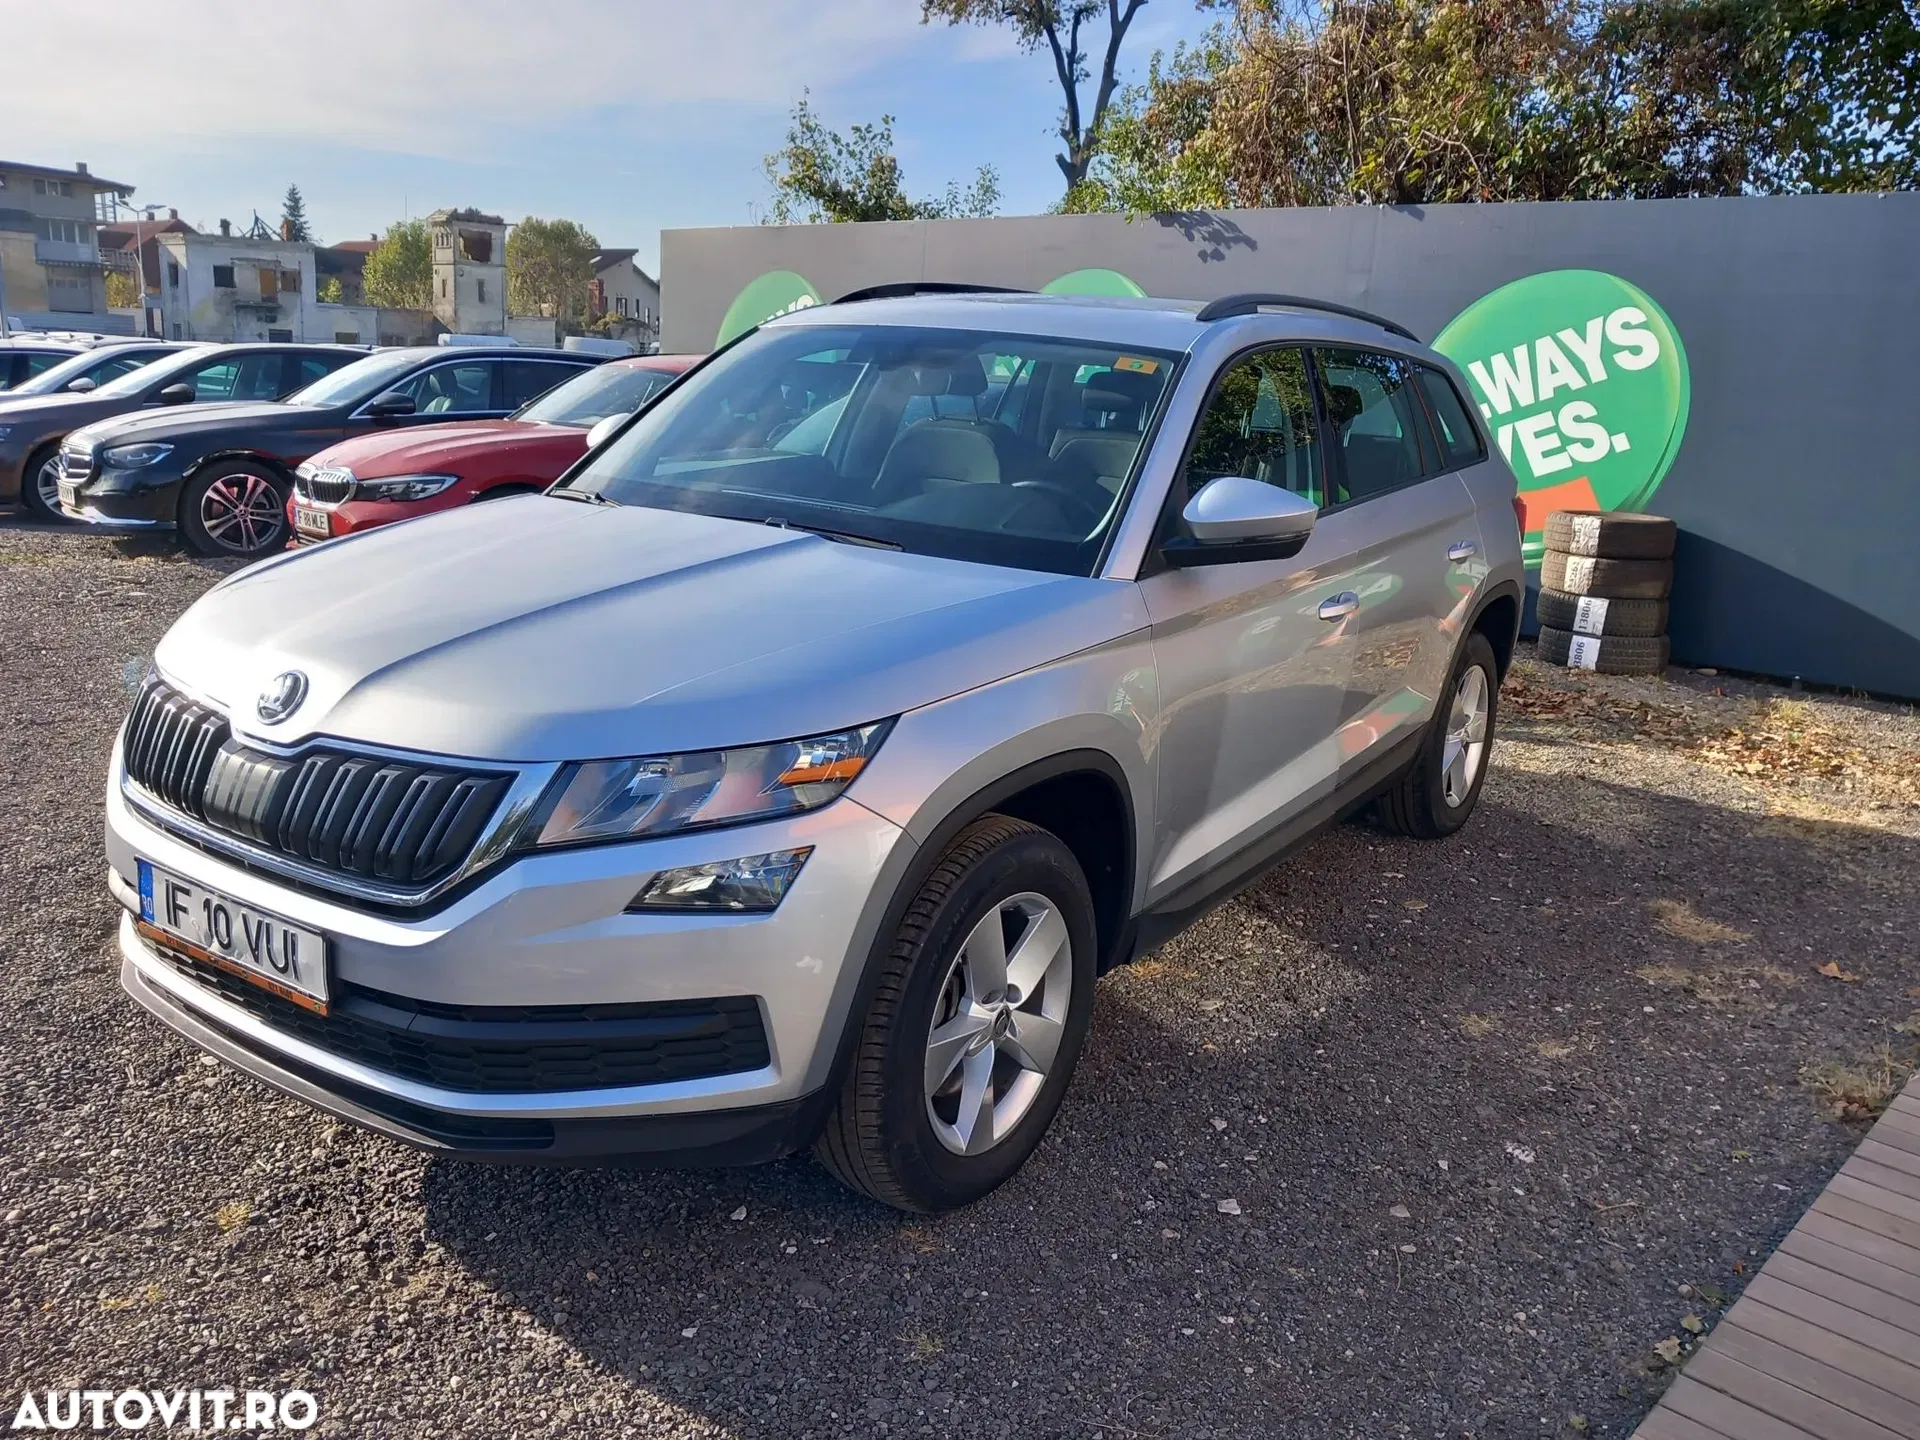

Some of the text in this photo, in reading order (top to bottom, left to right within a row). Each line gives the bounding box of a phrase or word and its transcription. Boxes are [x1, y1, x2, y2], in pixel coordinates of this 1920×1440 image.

[1468, 306, 1660, 419] WAYS
[1579, 599, 1593, 631] 13806
[1572, 641, 1586, 669] 3806
[141, 893, 153, 915] RO
[165, 878, 191, 930] IF
[203, 897, 233, 950] 10
[241, 911, 300, 982] VUI
